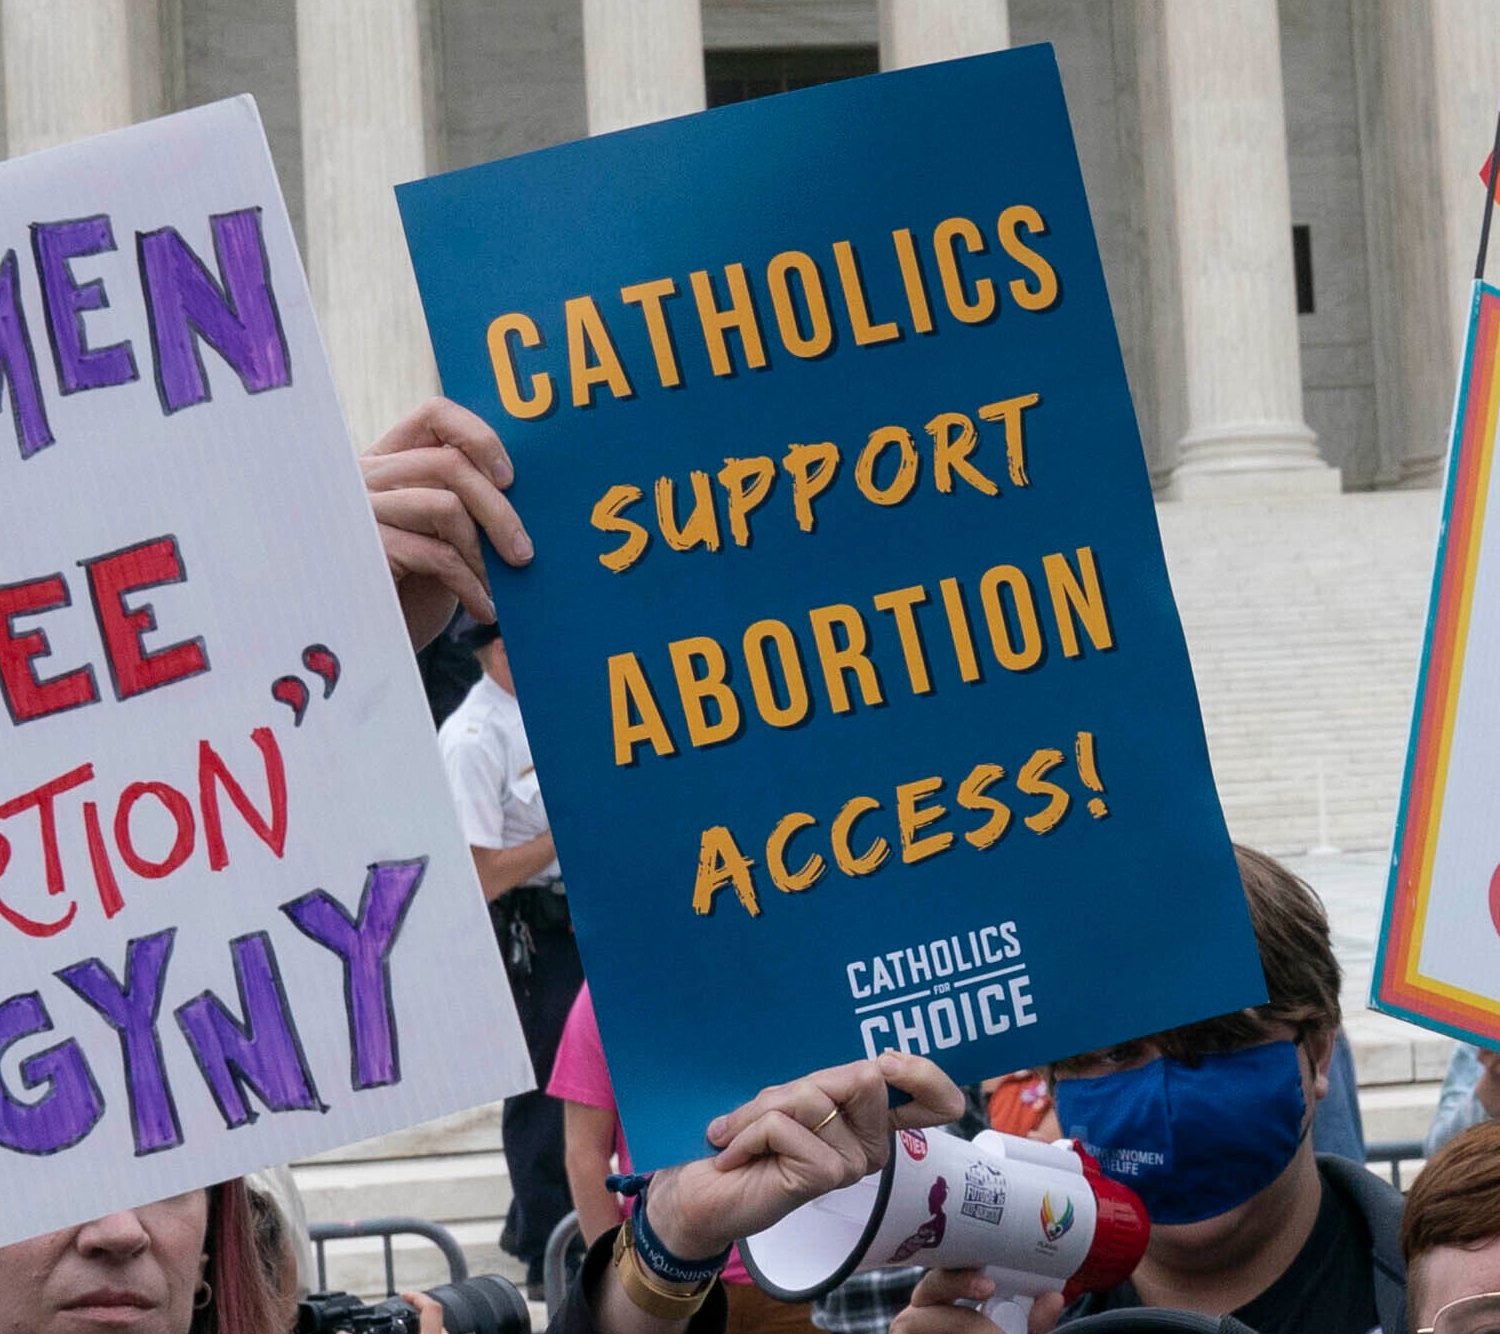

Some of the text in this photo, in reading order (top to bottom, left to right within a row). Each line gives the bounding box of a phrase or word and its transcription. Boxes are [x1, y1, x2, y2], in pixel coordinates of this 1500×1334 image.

[485, 203, 1062, 420] CATHOLICS
[590, 392, 1043, 575] SUPPORT
[606, 545, 1115, 767] ABORTION
[691, 730, 1111, 920] ACCESS!
[846, 921, 1021, 999] CATHOLICS
[860, 975, 1038, 1061] CHOICE
[933, 982, 951, 995] FOR
[1120, 1149, 1164, 1165] WOMEN
